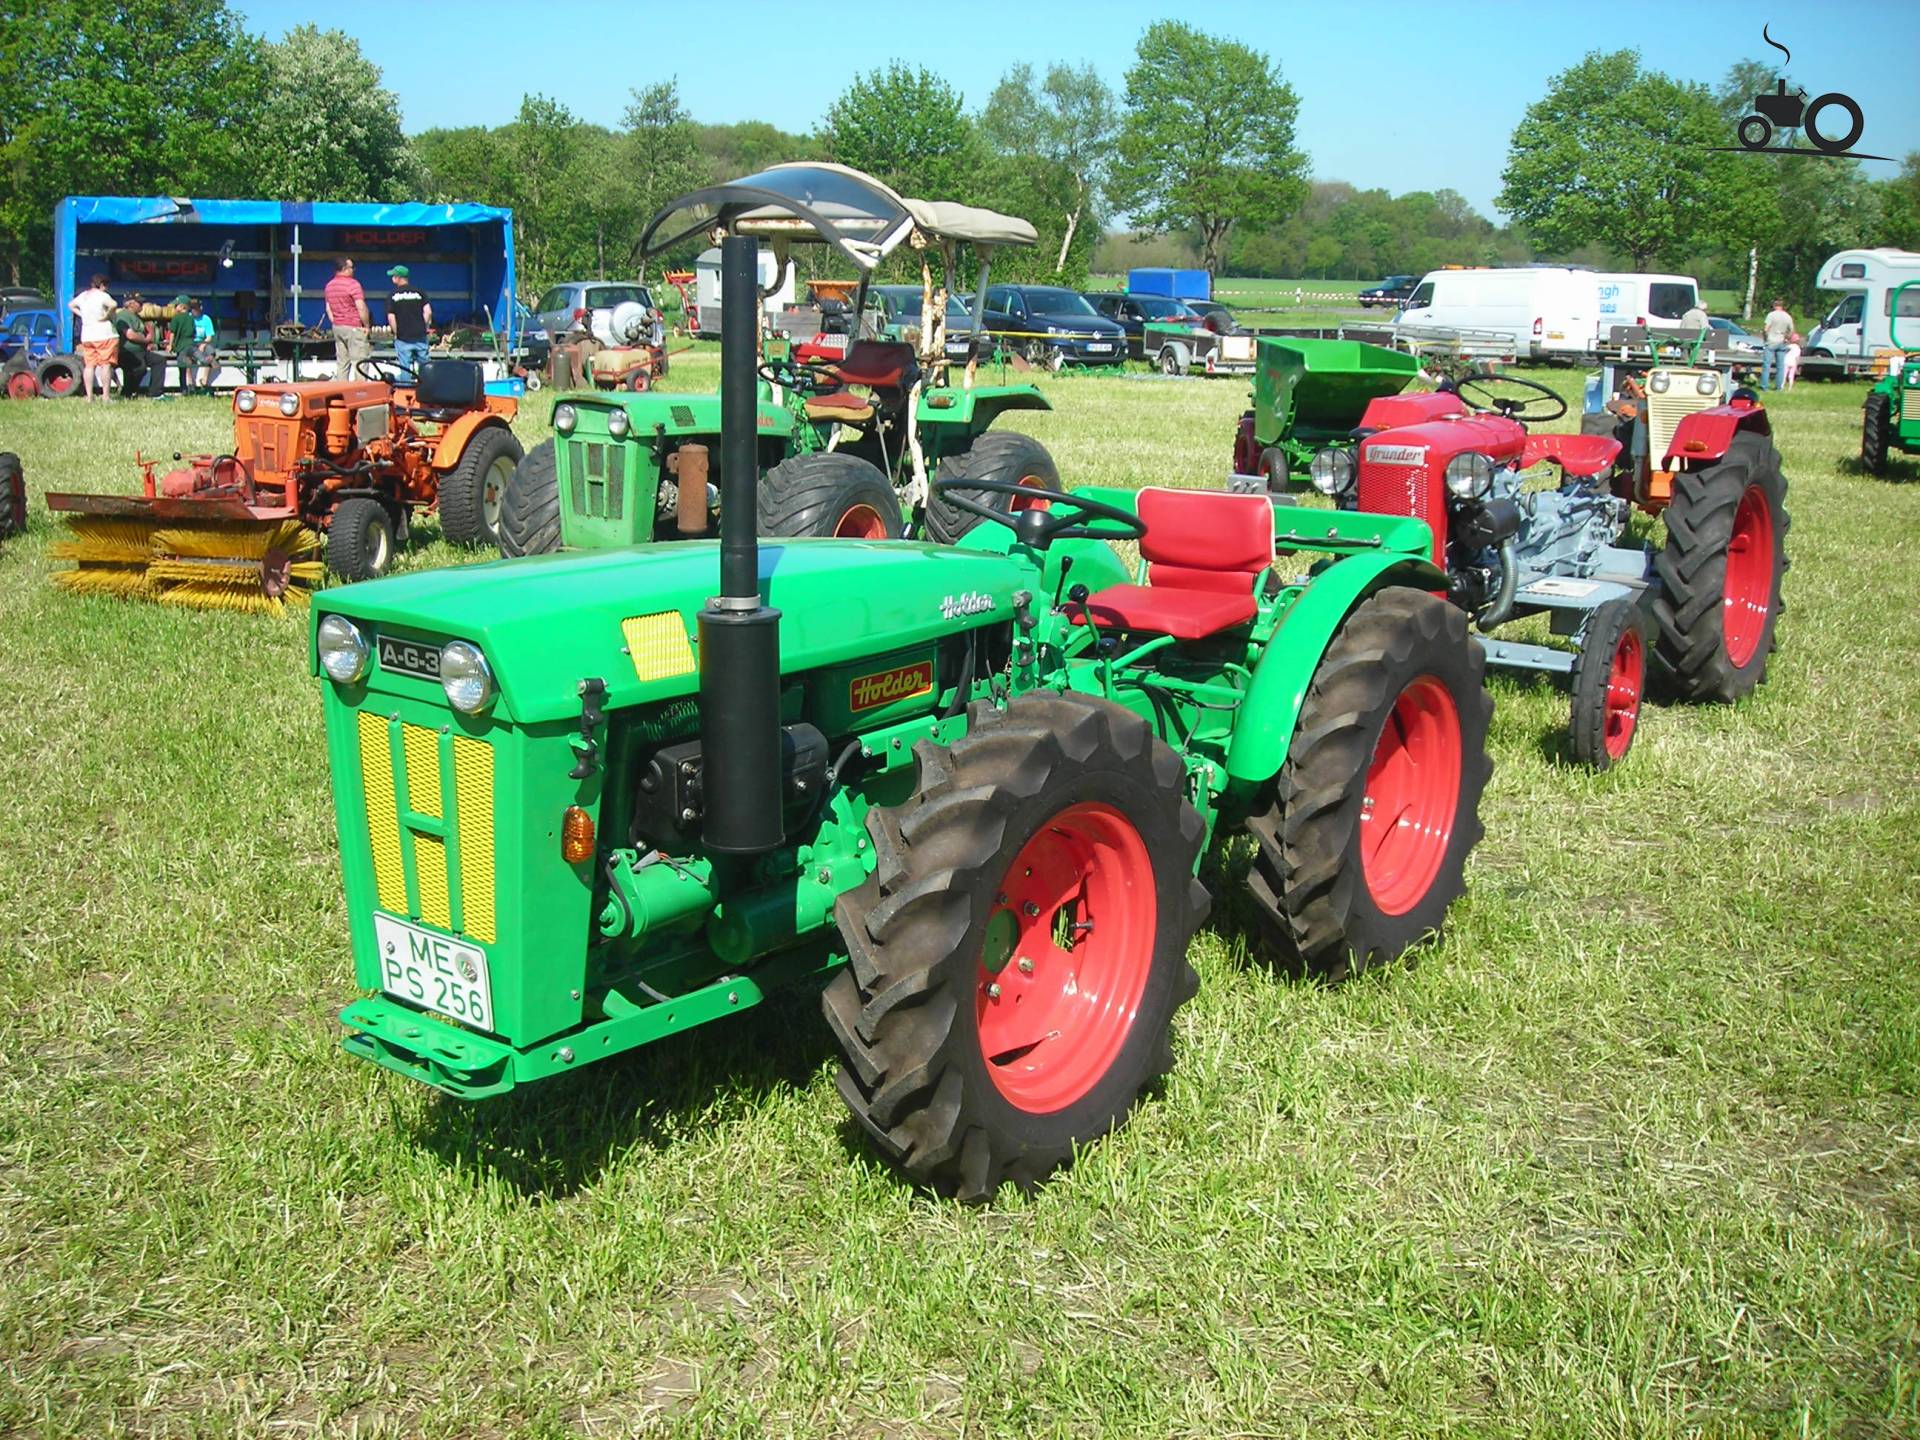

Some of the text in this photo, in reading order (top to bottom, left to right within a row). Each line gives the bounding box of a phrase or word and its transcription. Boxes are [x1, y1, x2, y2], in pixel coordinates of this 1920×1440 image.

[344, 231, 426, 246] HOLDER
[119, 260, 209, 275] HOLDER
[939, 590, 997, 620] Holder
[382, 643, 440, 673] A-G-3
[854, 670, 930, 705] Holder
[408, 931, 454, 977] ME
[385, 957, 484, 1023] PS 256
